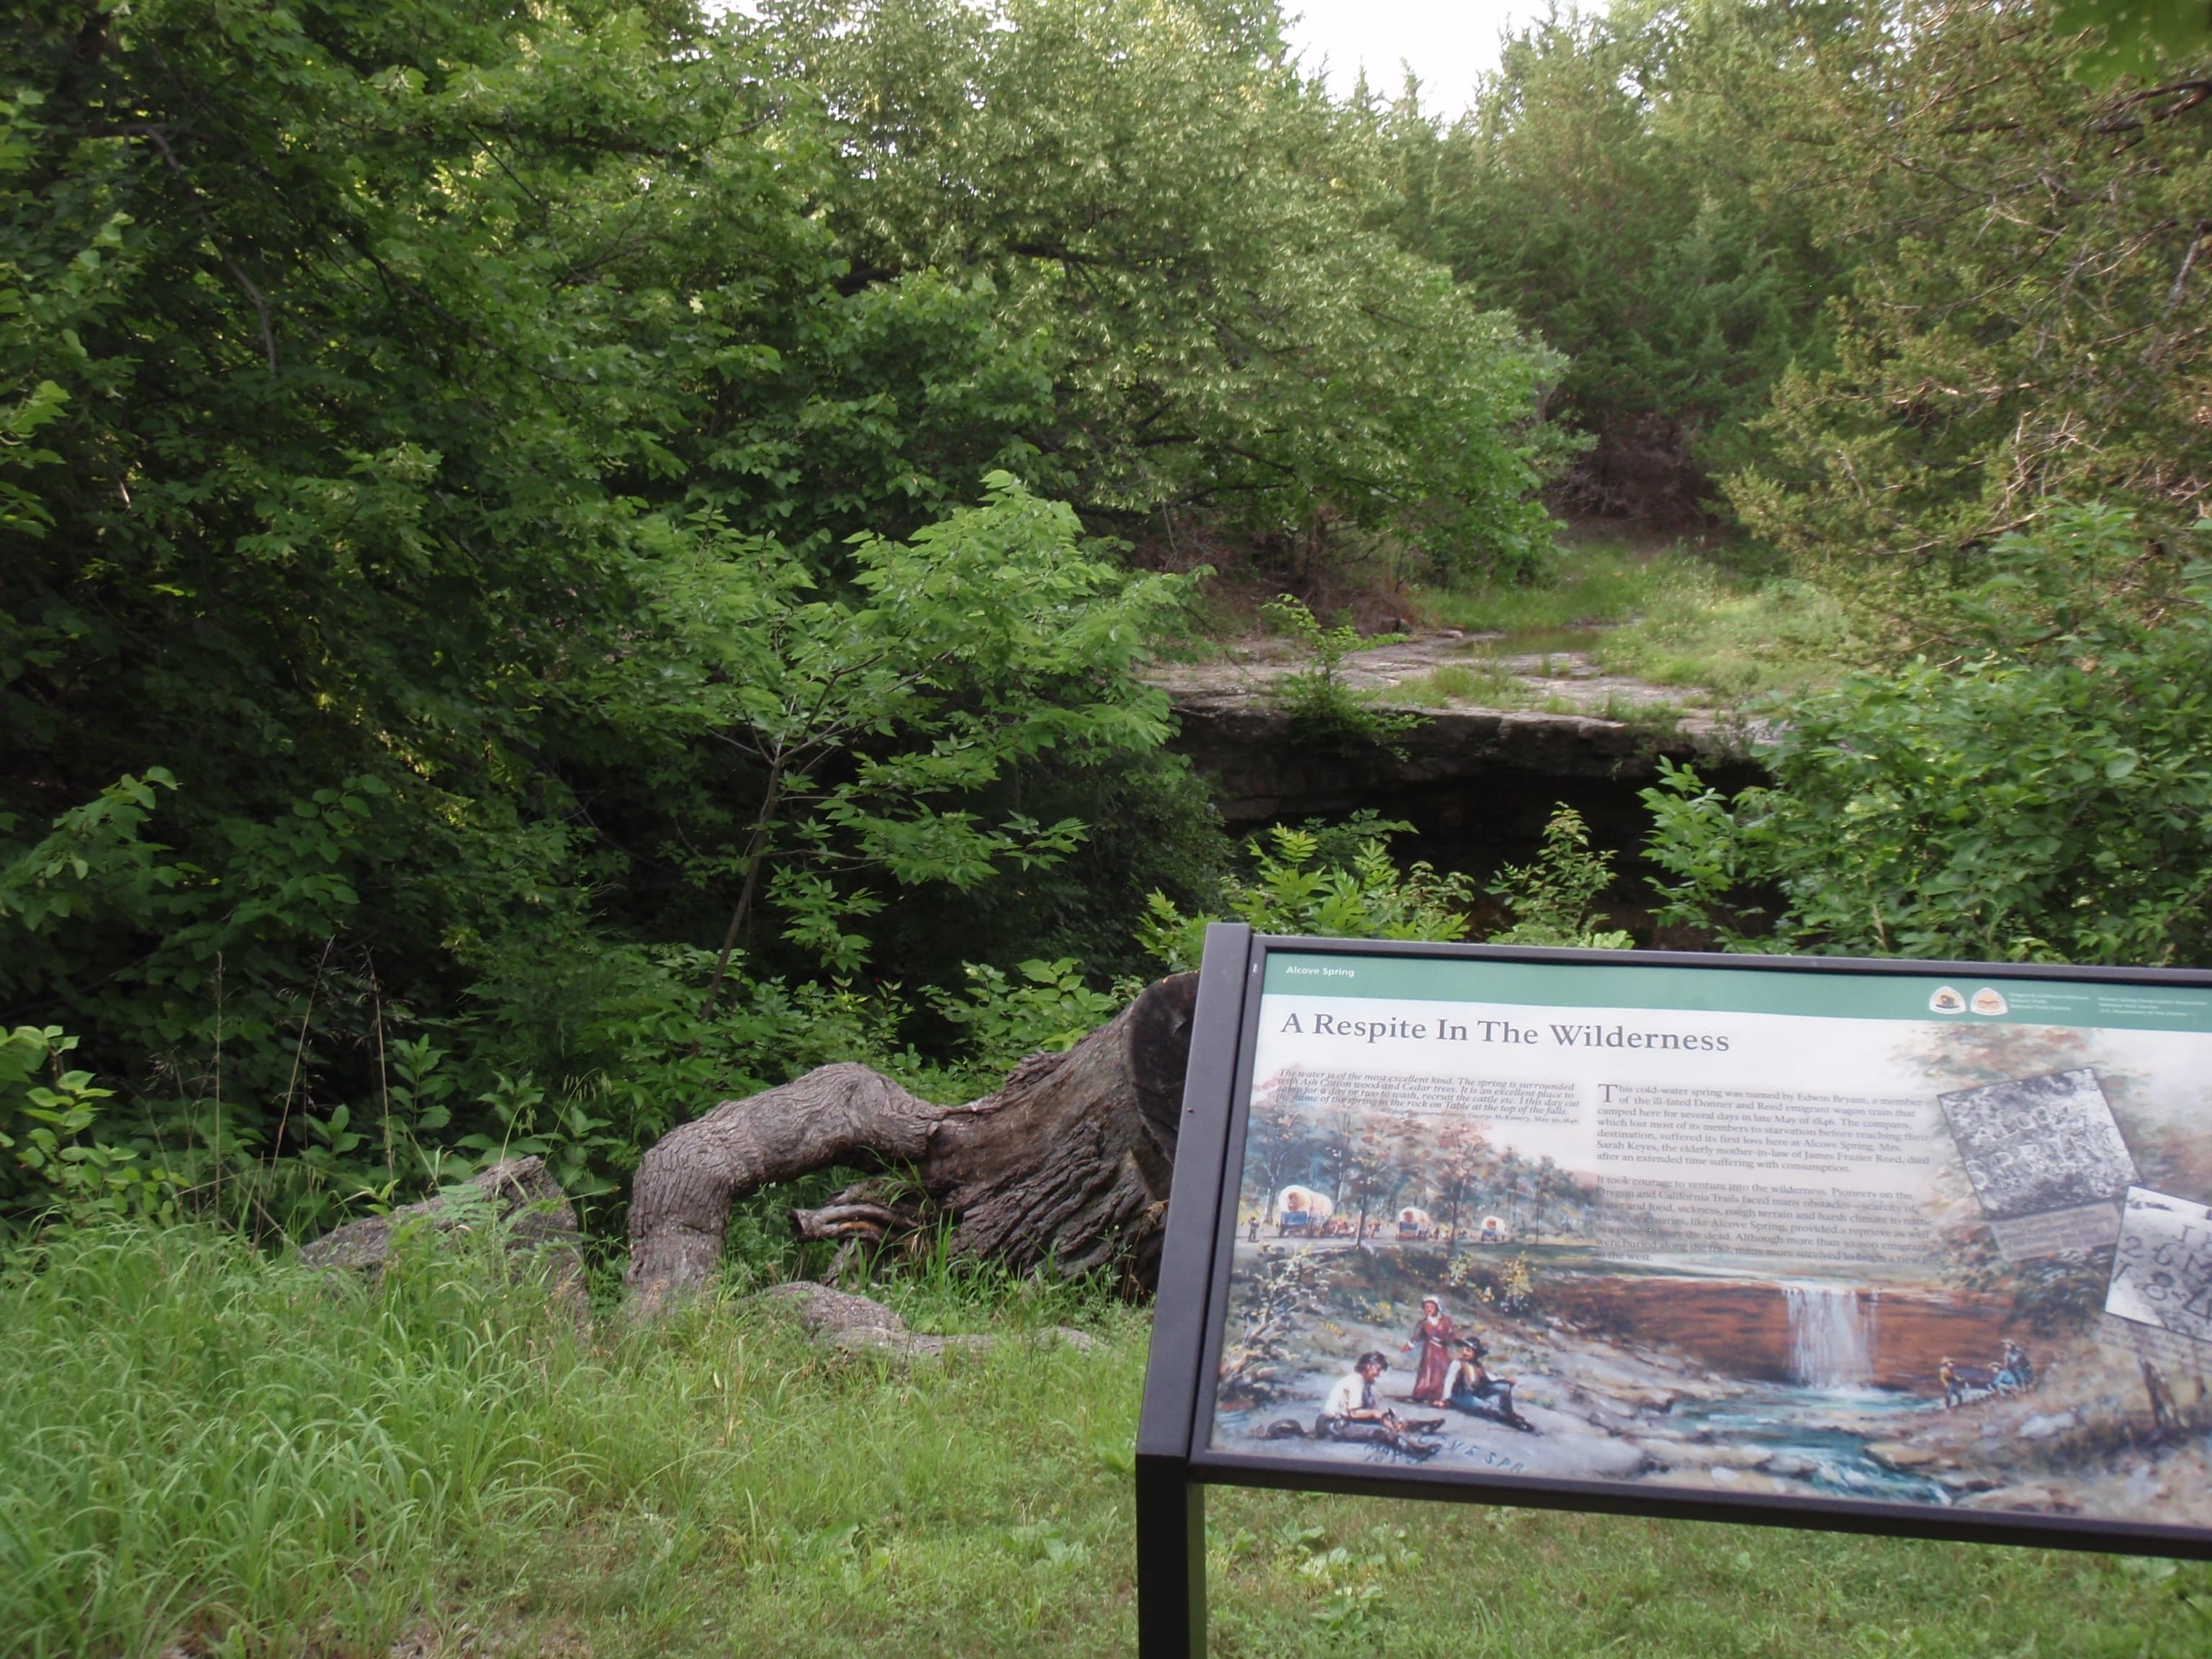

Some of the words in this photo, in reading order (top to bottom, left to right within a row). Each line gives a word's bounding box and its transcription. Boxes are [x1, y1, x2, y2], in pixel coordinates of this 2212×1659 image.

[1286, 965, 1320, 975] Alcove
[1322, 966, 1354, 979] Spring
[1281, 1012, 1304, 1033] A
[1312, 1012, 1426, 1044] Respite
[1436, 1017, 1468, 1041] In
[1478, 1020, 1539, 1044] The
[1548, 1023, 1730, 1052] Wilderness
[1320, 1079, 1352, 1088] Cotton
[1354, 1081, 1380, 1089] wood
[1402, 1082, 1430, 1092] Cedar
[1494, 1088, 1536, 1097] excellent
[1537, 1089, 1562, 1100] place
[1388, 1075, 1429, 1084] excellent
[1478, 1080, 1507, 1089] spring
[1519, 1082, 1575, 1091] surrounded
[1636, 1085, 1688, 1096] cold-water
[1692, 1089, 1722, 1100] spring
[1879, 1097, 1924, 1107] member
[1444, 1101, 1470, 1110] Table
[1694, 1099, 1732, 1109] Donner
[1757, 1102, 1783, 1111] Reed
[1786, 1105, 1829, 1115] emigrant
[1833, 1107, 1866, 1117] wagon
[1868, 1107, 1892, 1116] train
[1895, 1109, 1915, 1118] that
[1597, 1107, 1636, 1118] camped
[1639, 1108, 1660, 1118] here
[1681, 1111, 1714, 1120] several
[1717, 1112, 1738, 1123] days
[1754, 1113, 1771, 1123] late
[1597, 1118, 1627, 1127] which
[1629, 1118, 1647, 1128] lost
[1702, 1123, 1748, 1133] members
[1764, 1126, 1816, 1136] starvation
[1819, 1128, 1852, 1138] before
[1855, 1130, 1902, 1143] reaching
[1660, 1132, 1702, 1142] suffered
[1719, 1135, 1740, 1143] first
[1744, 1136, 1763, 1145] loss
[1766, 1137, 1789, 1146] here
[1803, 1138, 1837, 1148] Alcove
[1597, 1140, 1624, 1149] Sarah
[1679, 1144, 1713, 1156] elderly
[1804, 1151, 1835, 1160] James
[1597, 1152, 1619, 1161] after
[1636, 1155, 1682, 1164] extended
[1709, 1158, 1754, 1170] suffering
[1757, 1160, 1779, 1169] with
[1607, 1177, 1630, 1185] took
[1687, 1182, 1726, 1190] venture
[1728, 1183, 1750, 1192] into
[1658, 1191, 1709, 1202] California
[1743, 1195, 1769, 1205] faced
[1758, 1209, 1793, 1218] terrain
[1790, 1225, 1837, 1234] provided
